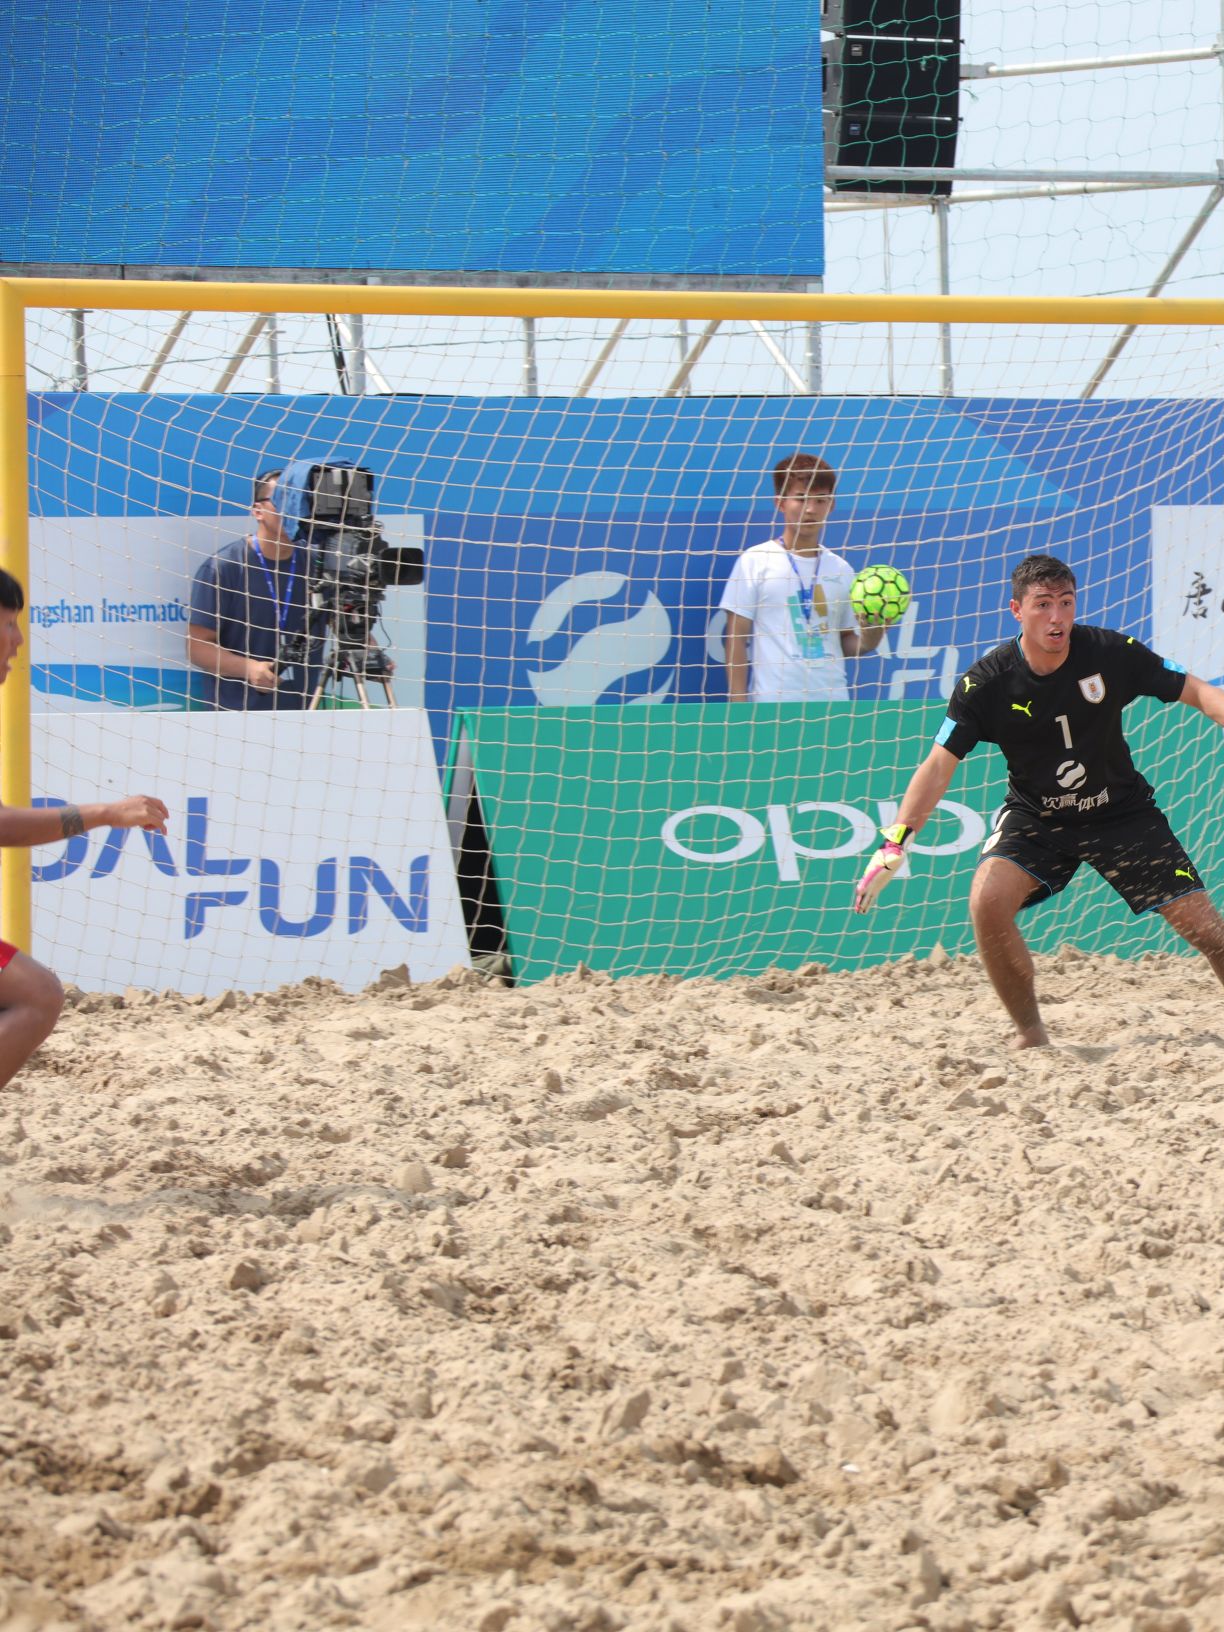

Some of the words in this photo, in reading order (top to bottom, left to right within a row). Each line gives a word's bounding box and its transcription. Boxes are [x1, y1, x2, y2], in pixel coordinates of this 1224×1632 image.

[30, 599, 95, 628] ngshan
[102, 598, 189, 624] Internatio
[1055, 714, 1073, 749] 1
[661, 799, 1012, 882] opp
[184, 854, 430, 940] FUN
